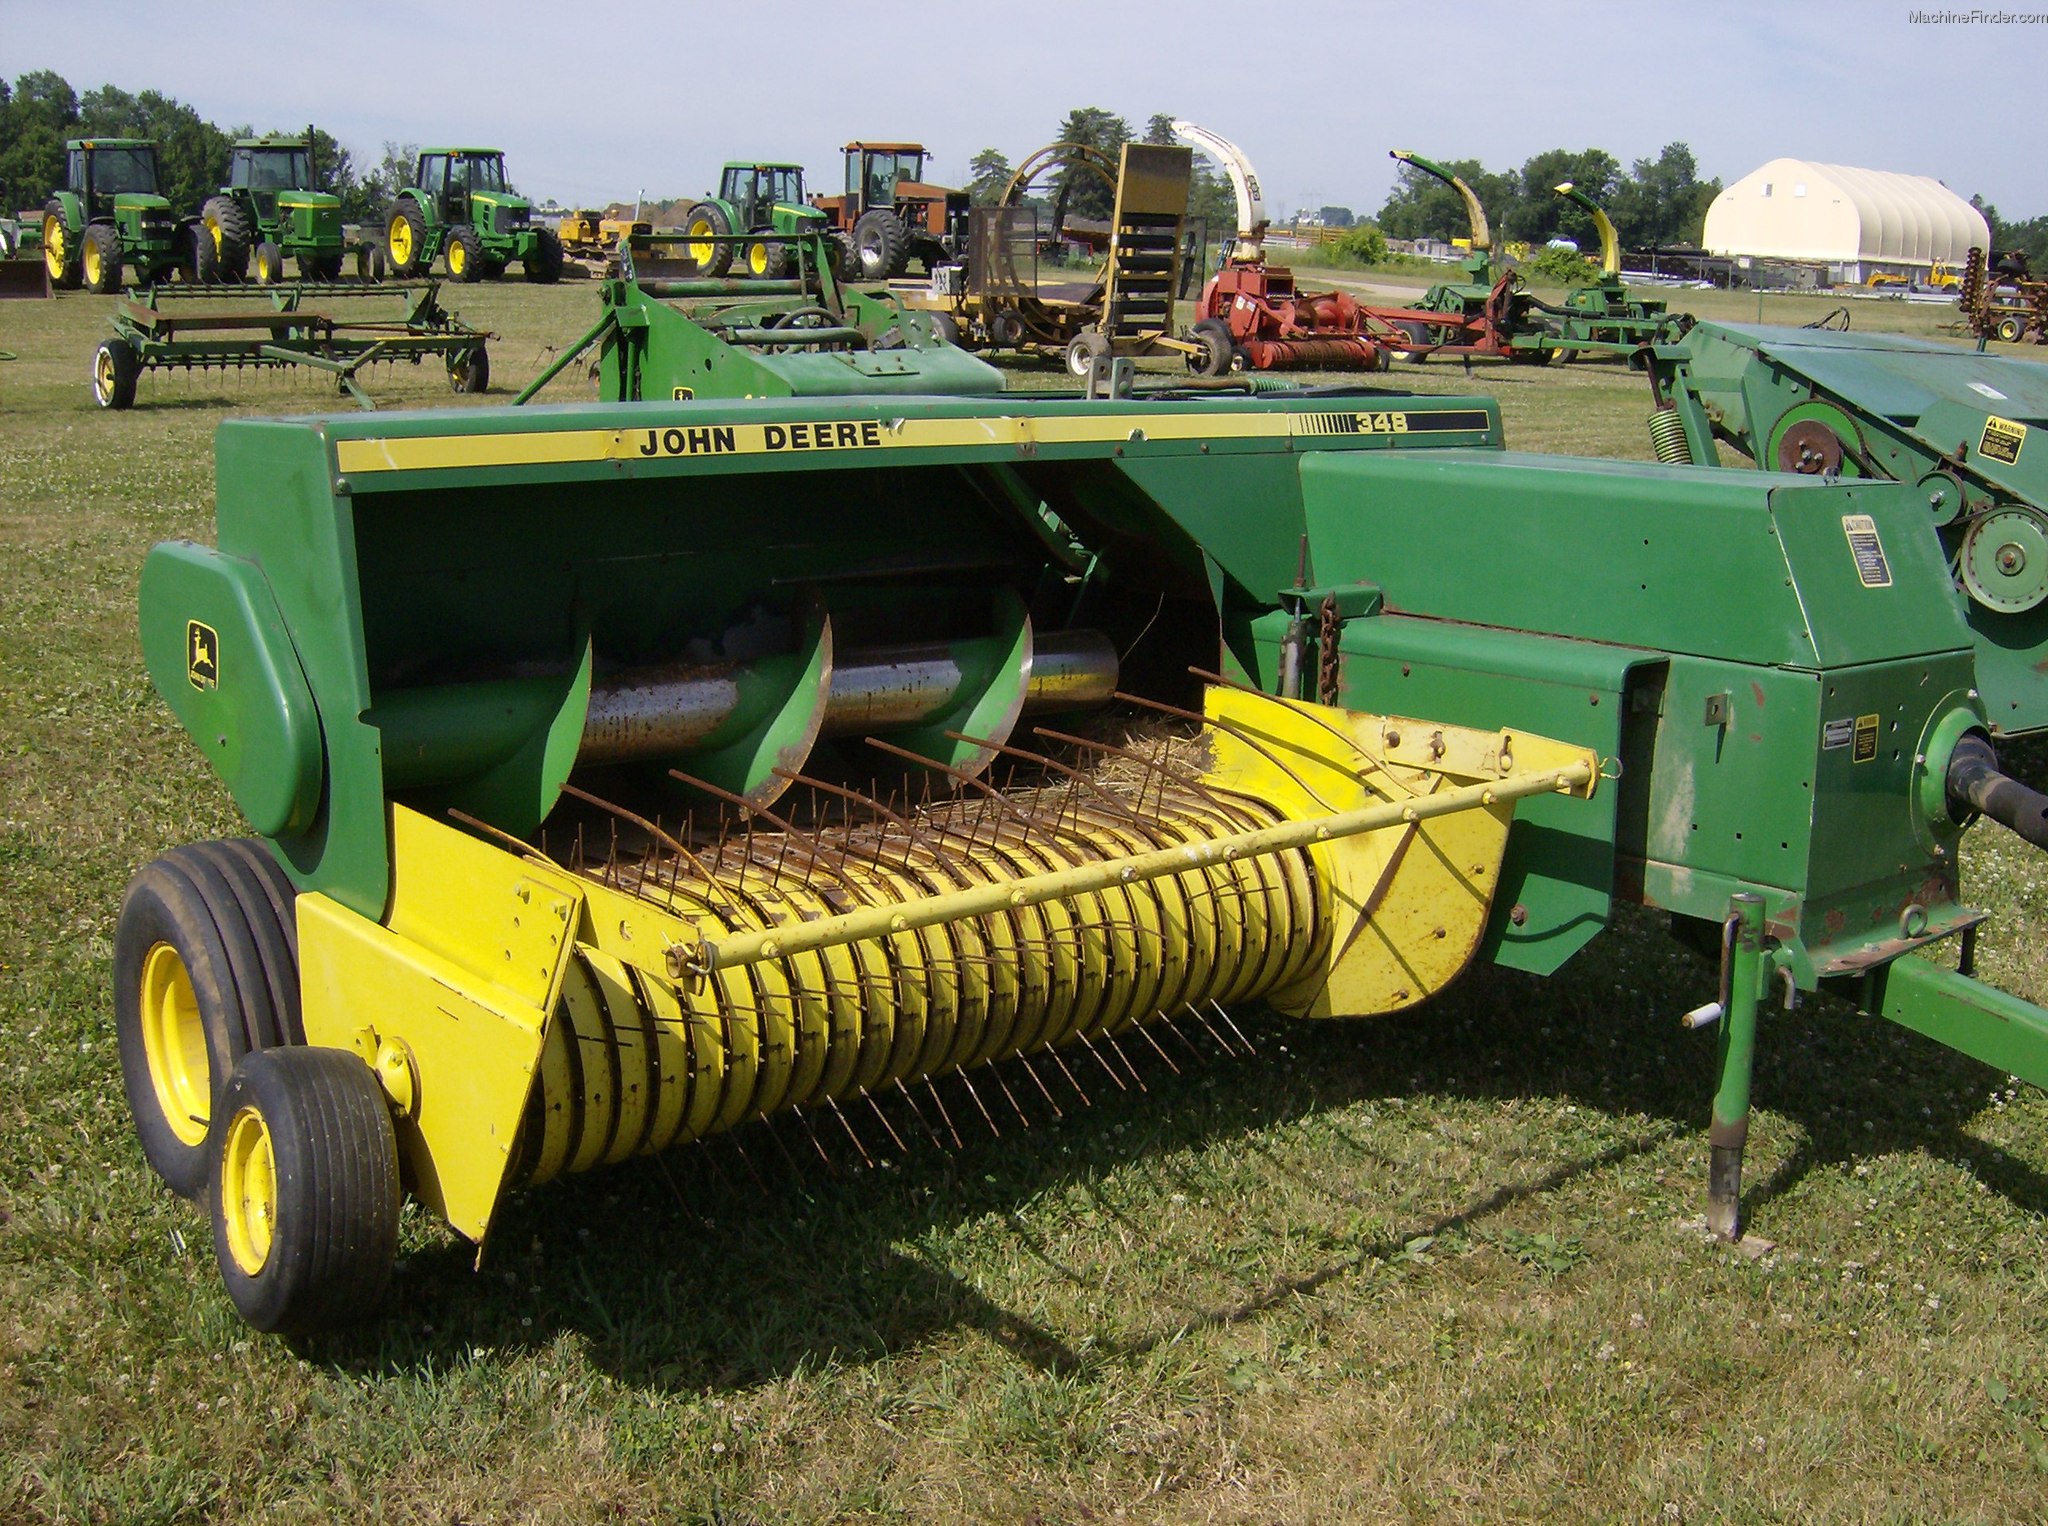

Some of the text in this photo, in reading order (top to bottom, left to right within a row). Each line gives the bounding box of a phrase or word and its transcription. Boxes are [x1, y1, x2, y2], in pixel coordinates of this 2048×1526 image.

[1356, 411, 1409, 433] 348
[639, 423, 882, 456] JOHN DEERE
